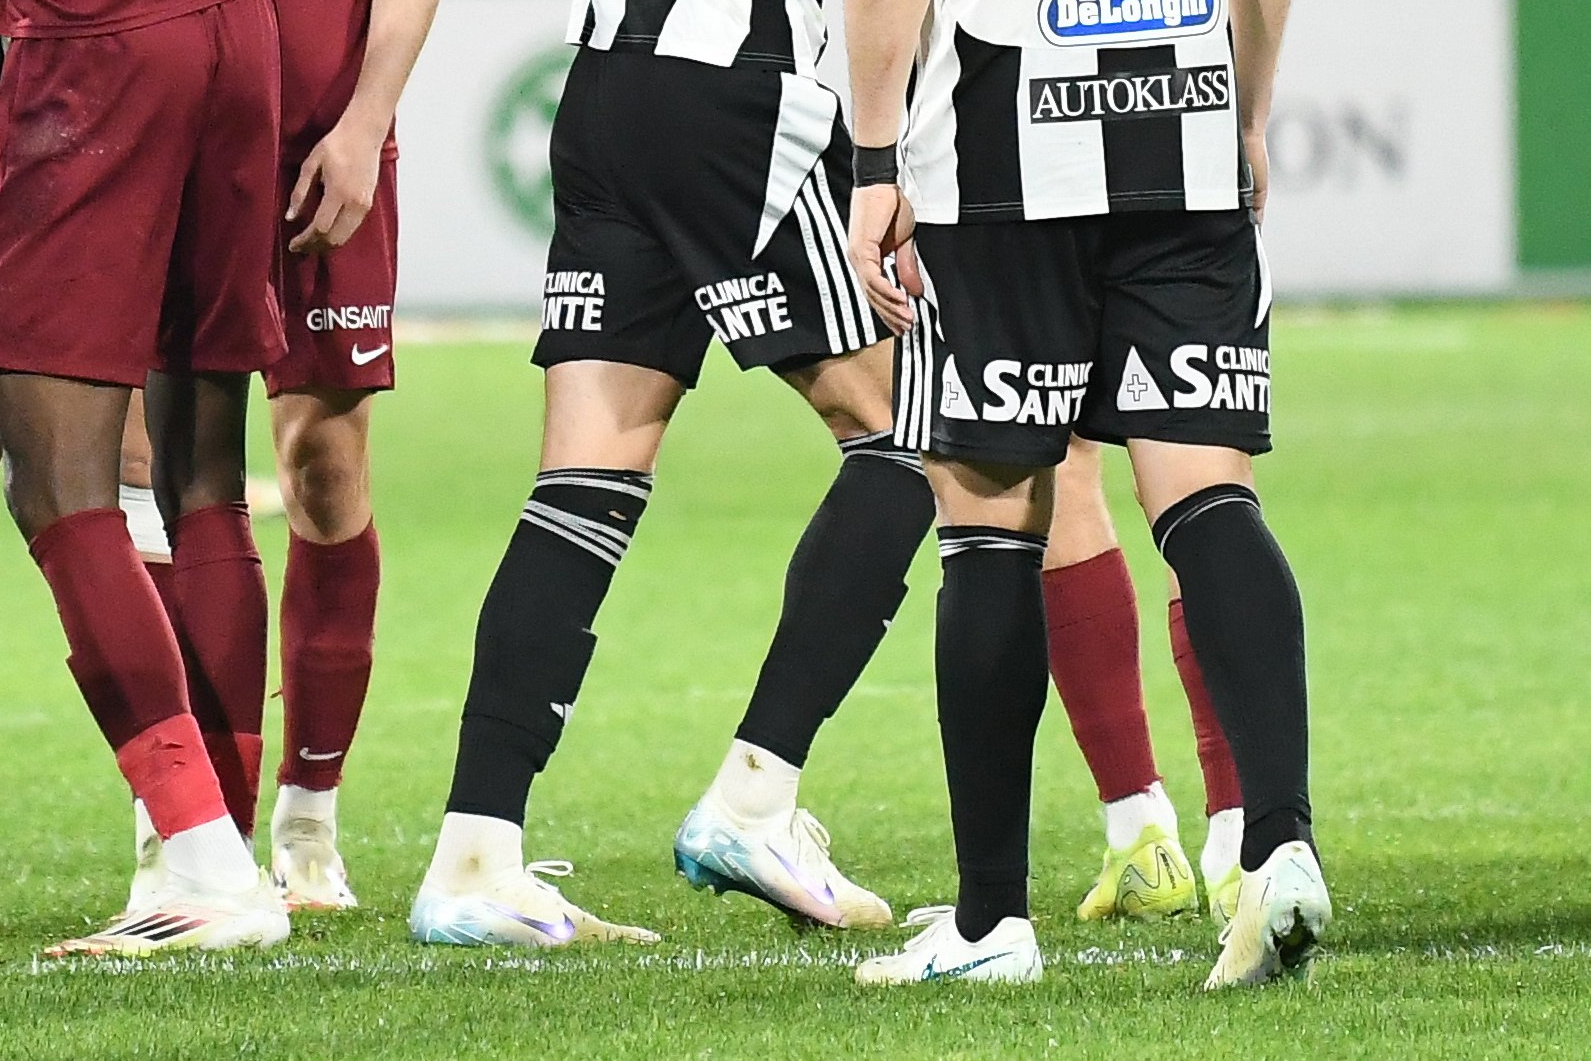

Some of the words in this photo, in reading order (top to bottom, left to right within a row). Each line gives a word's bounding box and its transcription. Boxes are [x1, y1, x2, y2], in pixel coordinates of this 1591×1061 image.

[1032, 69, 1229, 120] AUTOKLASS
[694, 272, 785, 311] CLINICA
[306, 305, 391, 331] GINSAVIT
[1170, 344, 1271, 413] SANT
[1215, 345, 1270, 371] CLINIC
[982, 359, 1087, 426] SANT
